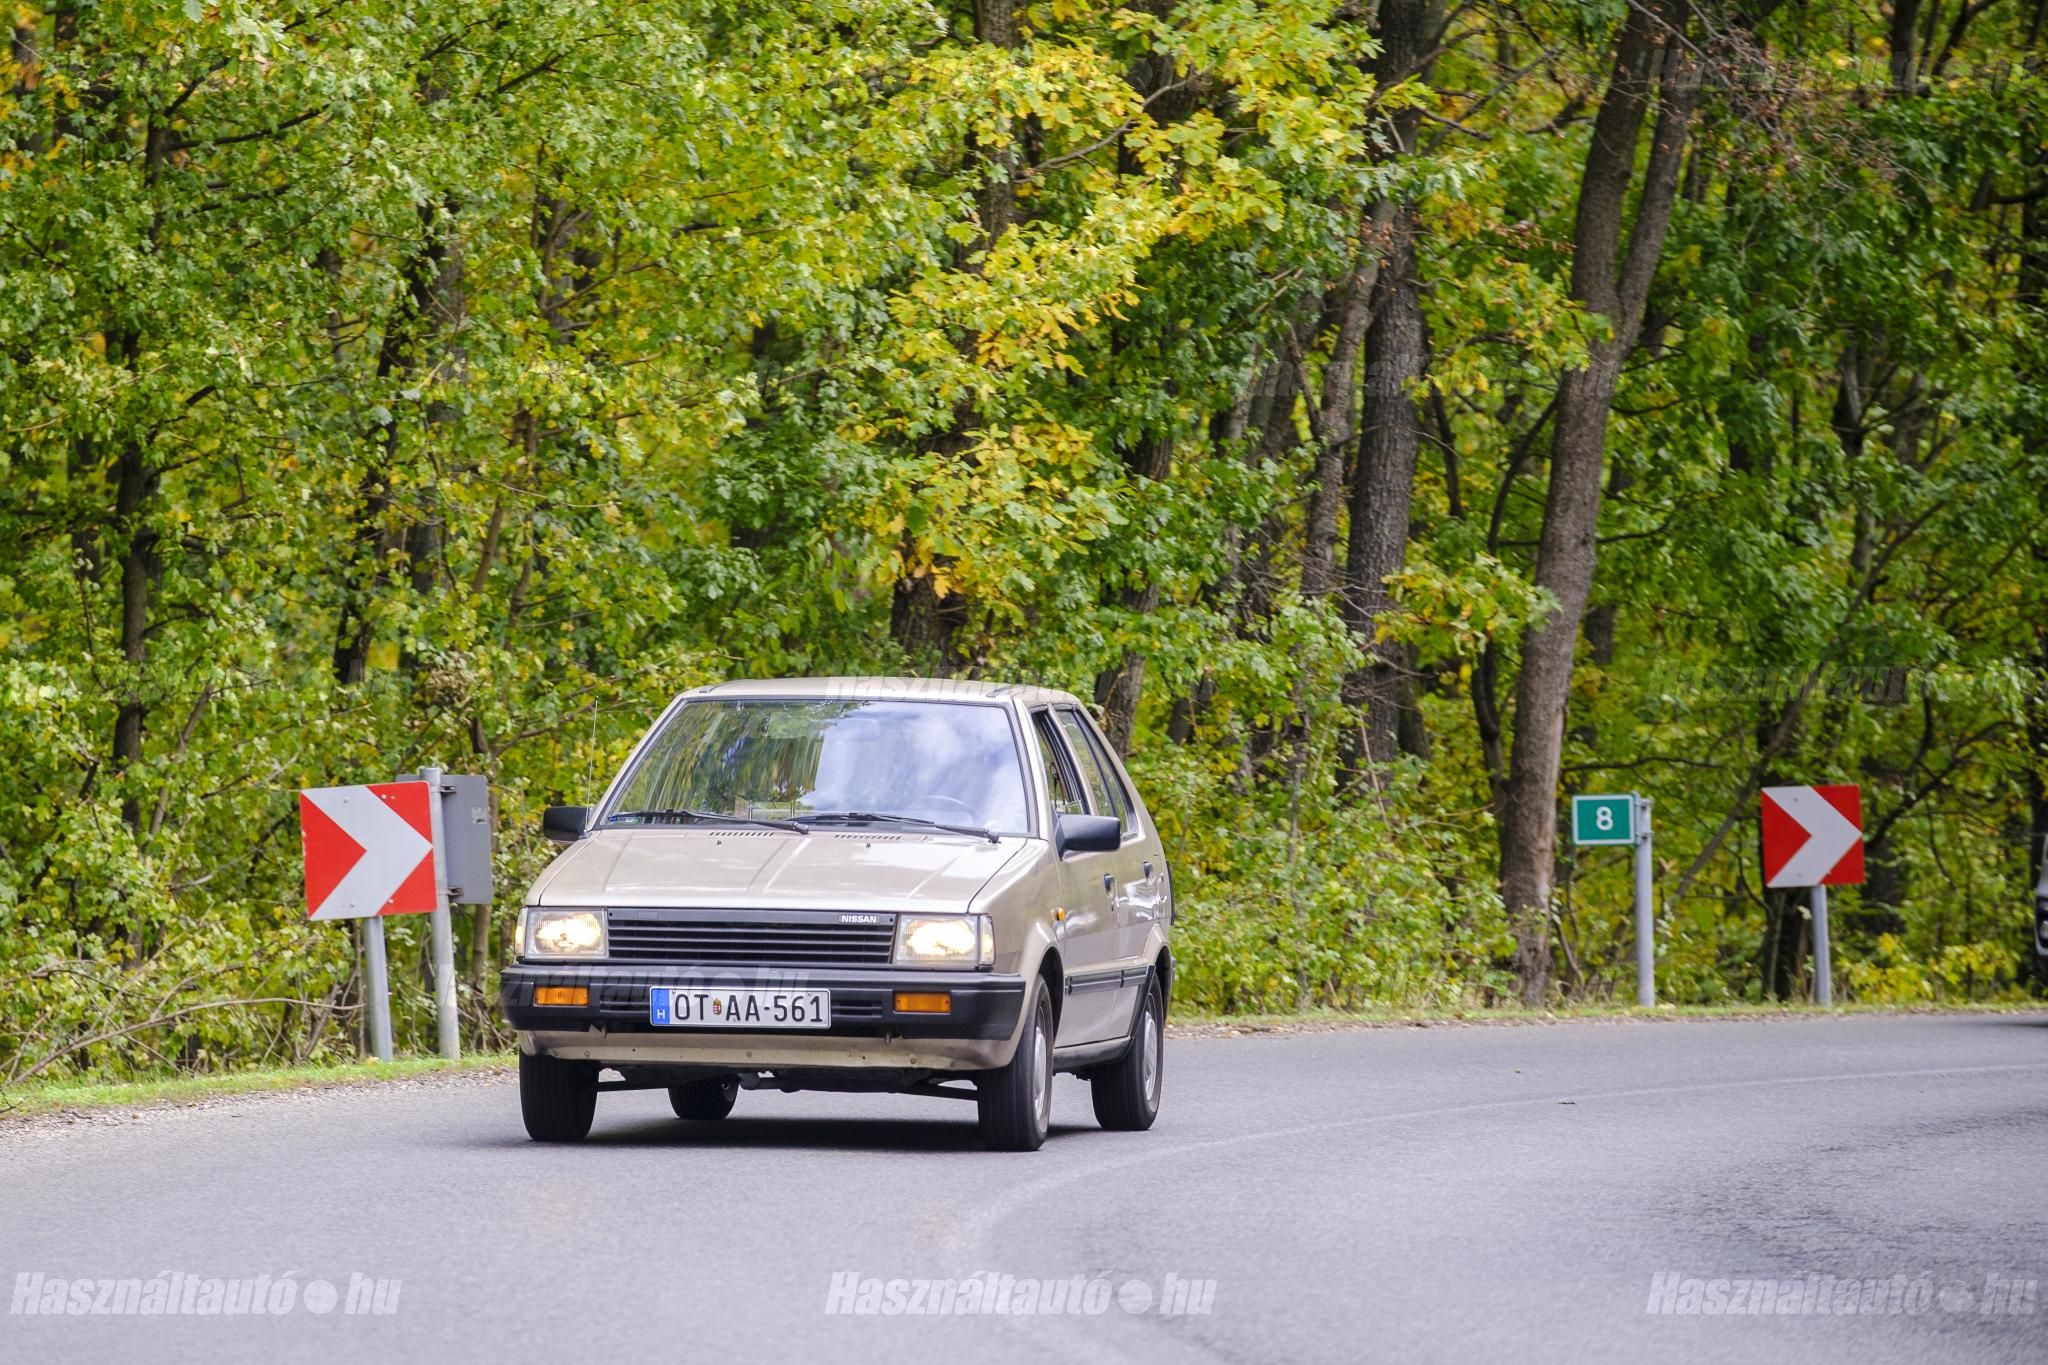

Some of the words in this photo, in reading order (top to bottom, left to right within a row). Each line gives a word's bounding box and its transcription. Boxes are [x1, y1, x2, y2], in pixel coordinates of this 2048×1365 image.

[1596, 806, 1614, 831] 8
[841, 914, 877, 923] NISSAN
[656, 1009, 666, 1019] H
[674, 994, 709, 1021] OT
[725, 994, 823, 1022] AA-561
